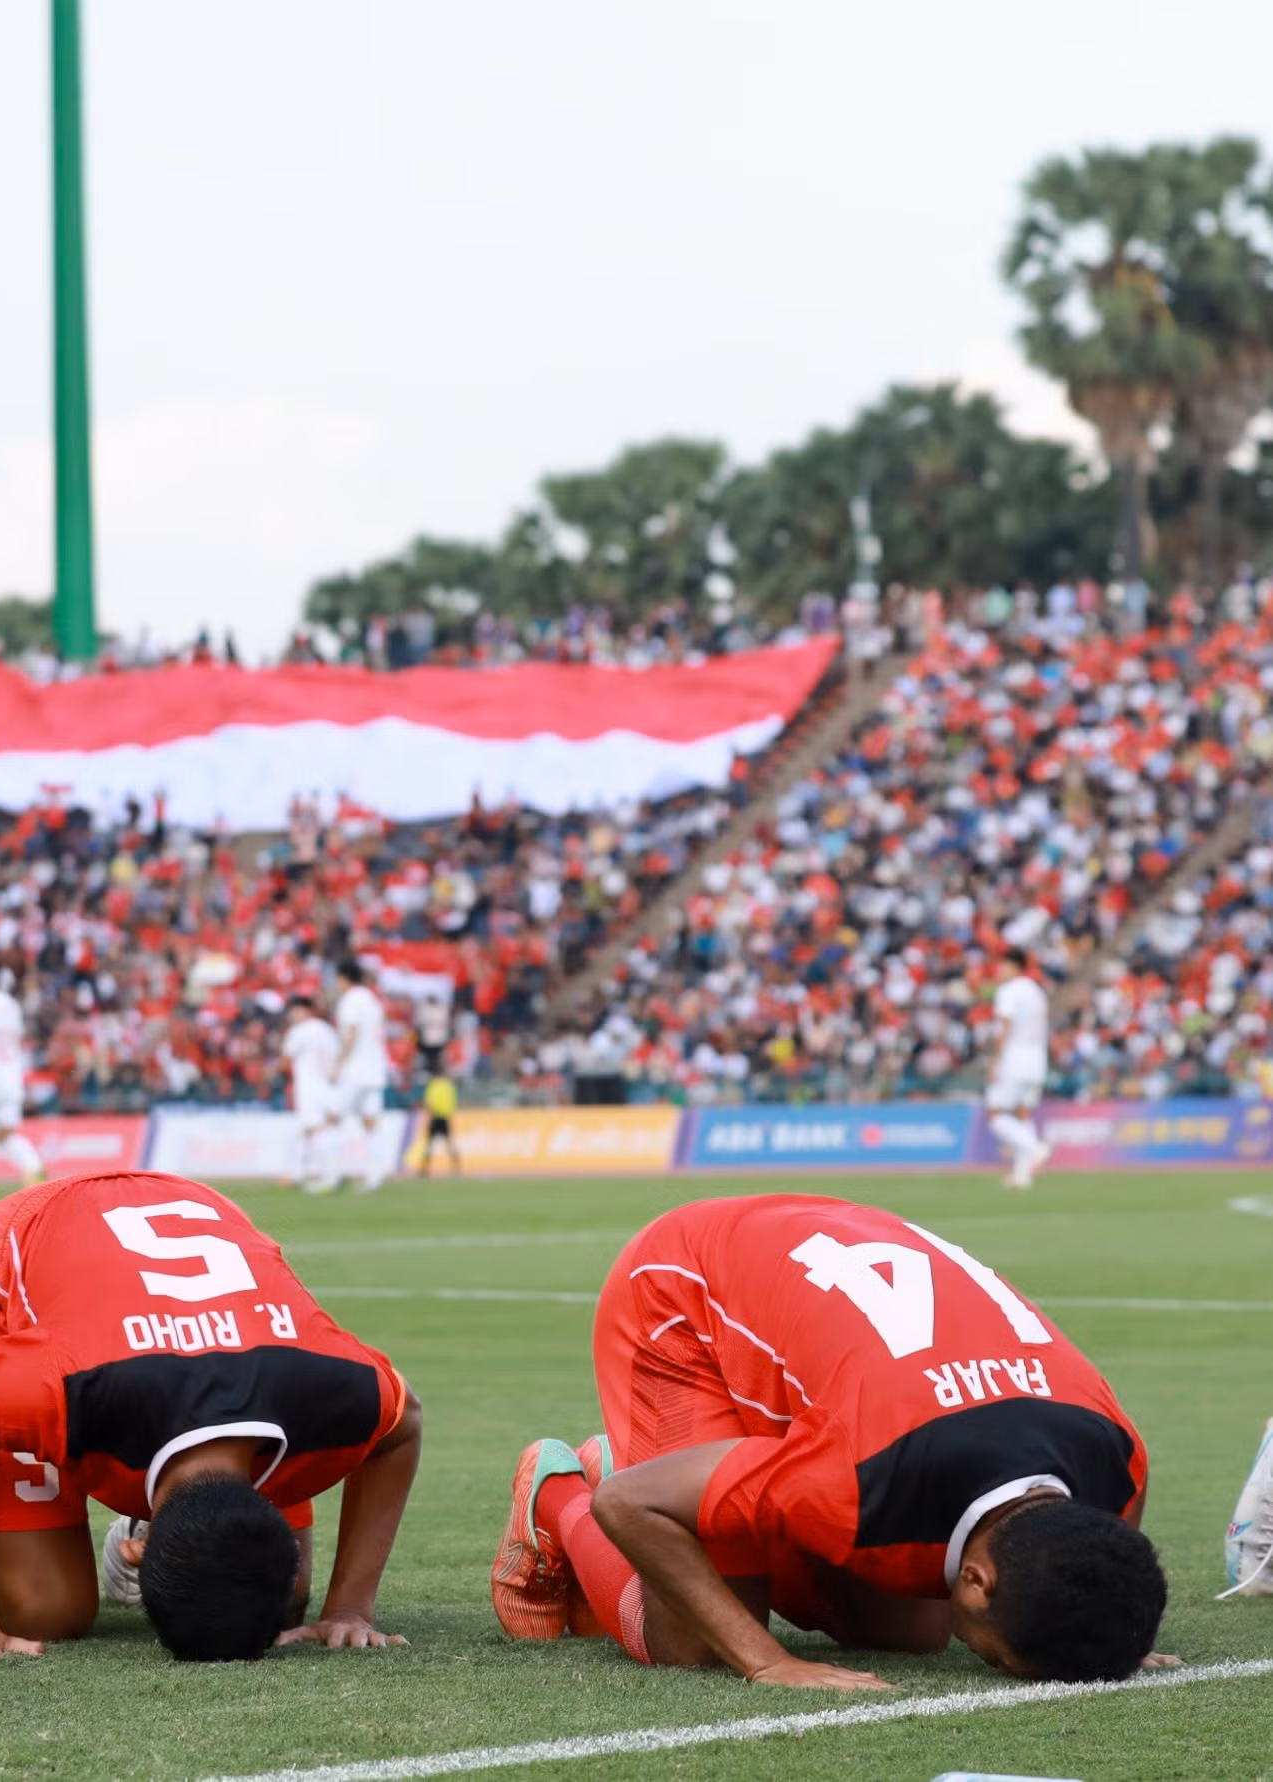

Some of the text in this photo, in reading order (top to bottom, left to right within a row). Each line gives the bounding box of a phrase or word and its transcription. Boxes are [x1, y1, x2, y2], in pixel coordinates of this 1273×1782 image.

[102, 1199, 258, 1302] 5
[122, 1303, 298, 1352] R. RIDHO
[788, 1222, 1053, 1359] 14
[923, 1358, 1052, 1408] FAJAR
